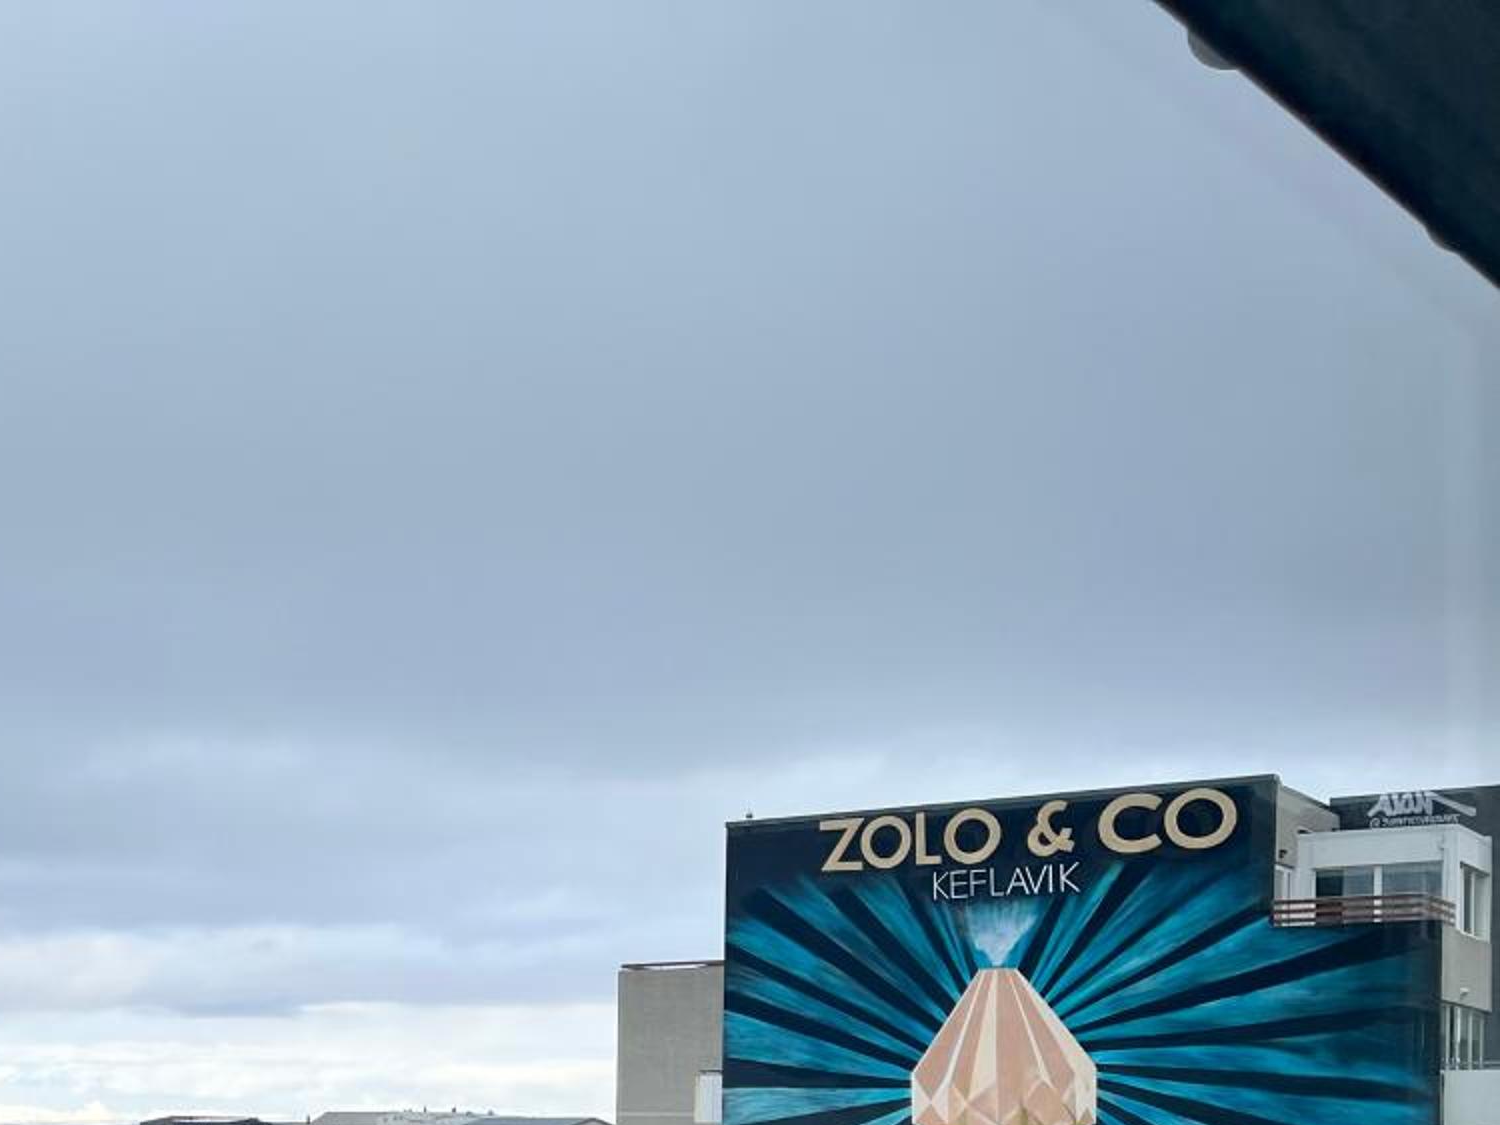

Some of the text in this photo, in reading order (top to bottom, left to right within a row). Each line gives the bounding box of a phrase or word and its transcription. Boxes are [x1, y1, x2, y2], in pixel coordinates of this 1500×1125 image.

[819, 787, 1237, 871] ZOLO & CO
[932, 860, 1080, 900] KEFLAVIK
